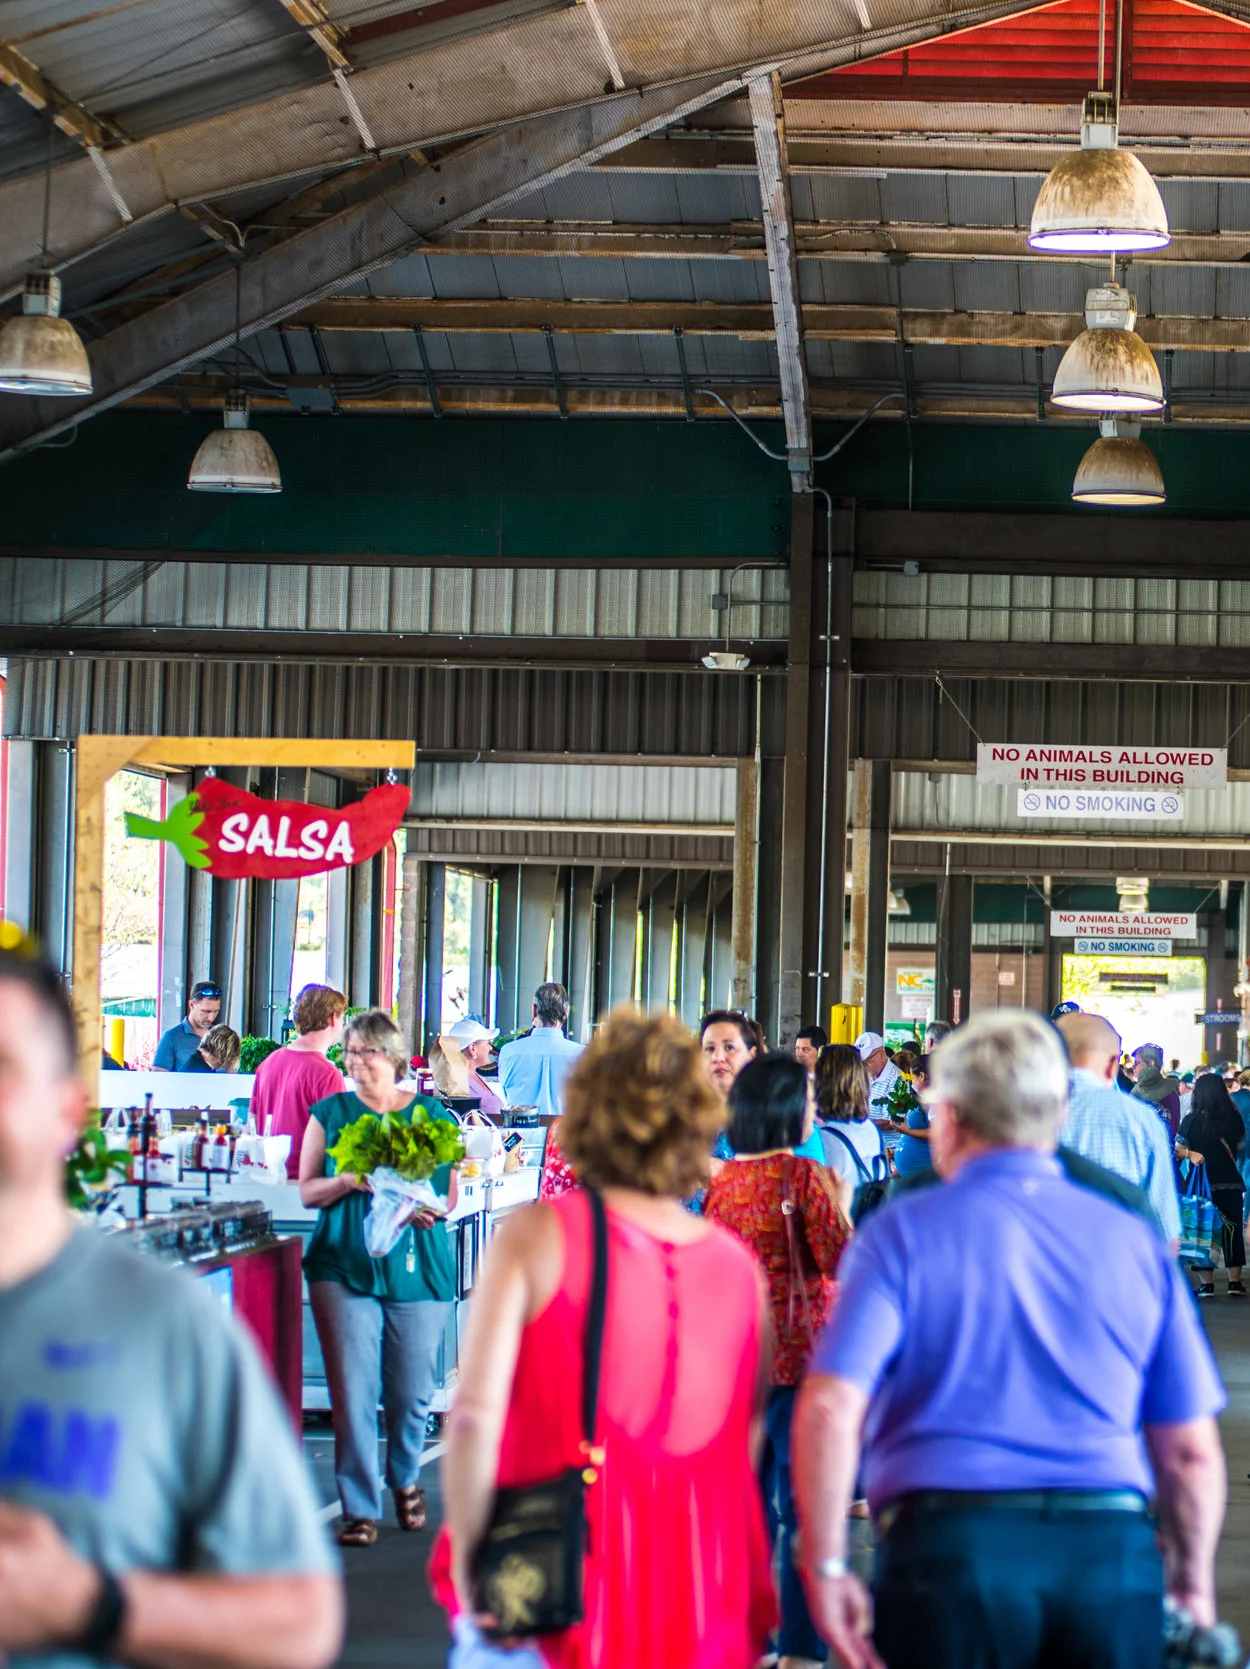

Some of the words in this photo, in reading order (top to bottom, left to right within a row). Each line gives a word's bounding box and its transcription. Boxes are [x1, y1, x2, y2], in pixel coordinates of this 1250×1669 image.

[992, 748, 1020, 761] NO
[1025, 748, 1113, 764] ANIMALS
[1118, 751, 1214, 766] ALLOWED
[1020, 767, 1039, 781] IN
[1042, 768, 1086, 782] THIS
[1092, 770, 1184, 785] BUILDING
[1045, 795, 1070, 811] NO
[1075, 796, 1156, 813] SMOKING
[218, 812, 355, 864] SALSA
[1059, 914, 1076, 923] NO
[1078, 915, 1129, 924] ANIMALS
[1133, 916, 1189, 925] ALLOWED
[1075, 926, 1087, 934] IN
[1089, 926, 1115, 935] THIS
[1117, 927, 1172, 936] BUILDING
[1090, 941, 1106, 951] NO
[1108, 942, 1155, 952] SMOKING
[897, 974, 923, 987] NC
